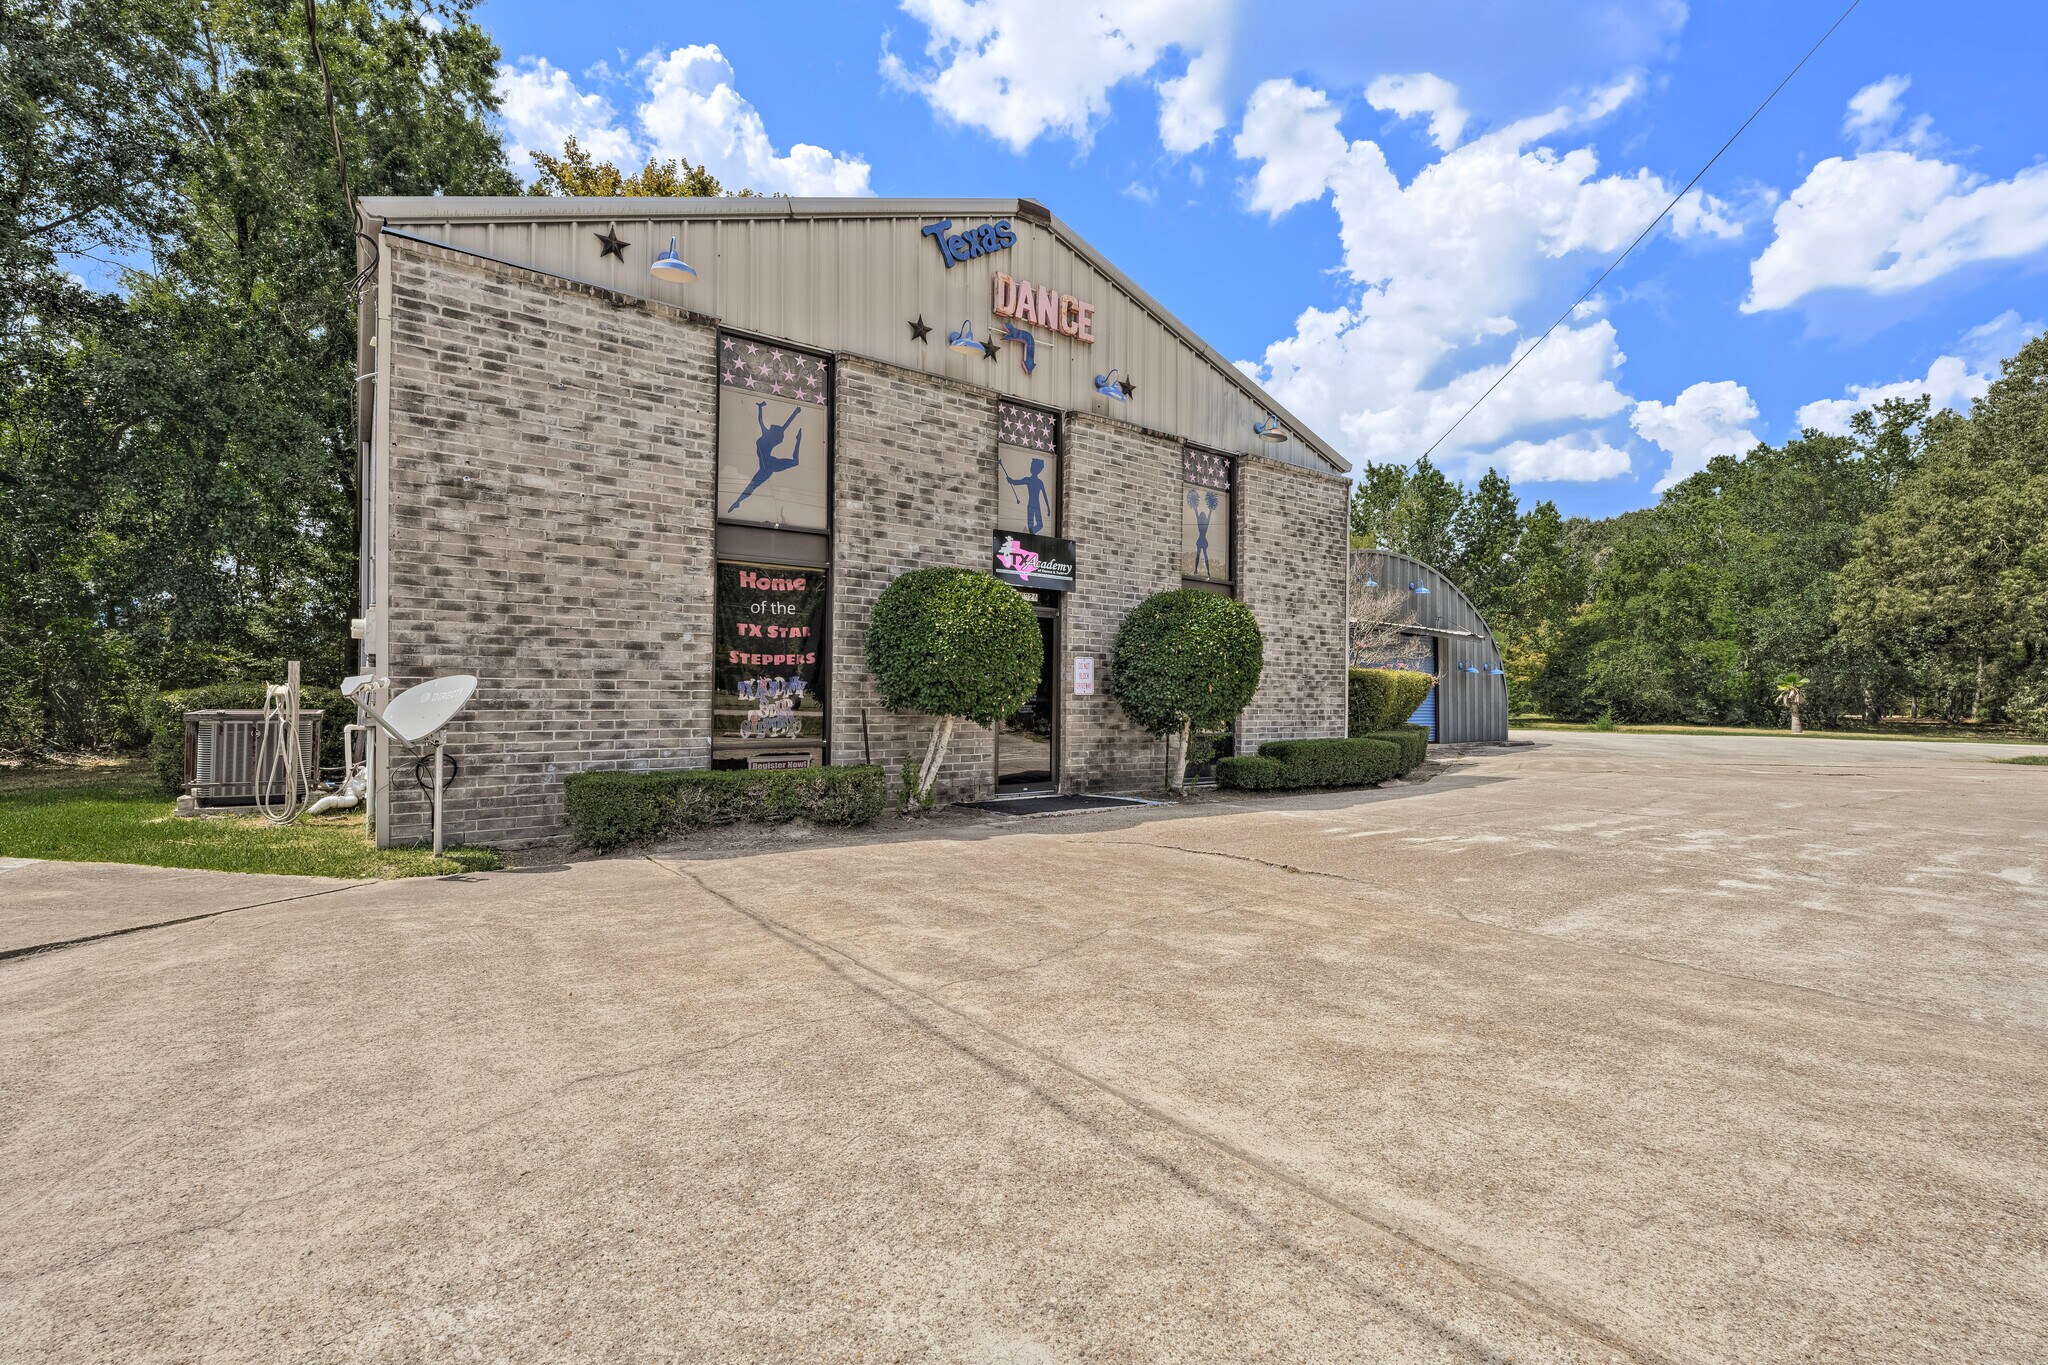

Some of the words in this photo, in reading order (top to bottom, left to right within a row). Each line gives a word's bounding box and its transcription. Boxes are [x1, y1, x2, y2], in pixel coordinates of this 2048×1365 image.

[921, 219, 1017, 268] Texas
[993, 271, 1095, 344] DANCE
[1021, 555, 1073, 575] Academy
[739, 570, 807, 591] Home
[750, 600, 767, 614] of
[770, 601, 796, 615] the
[736, 623, 762, 638] TX
[729, 650, 816, 666] STEPPERS
[752, 761, 787, 770] Register
[787, 760, 807, 769] Now!
